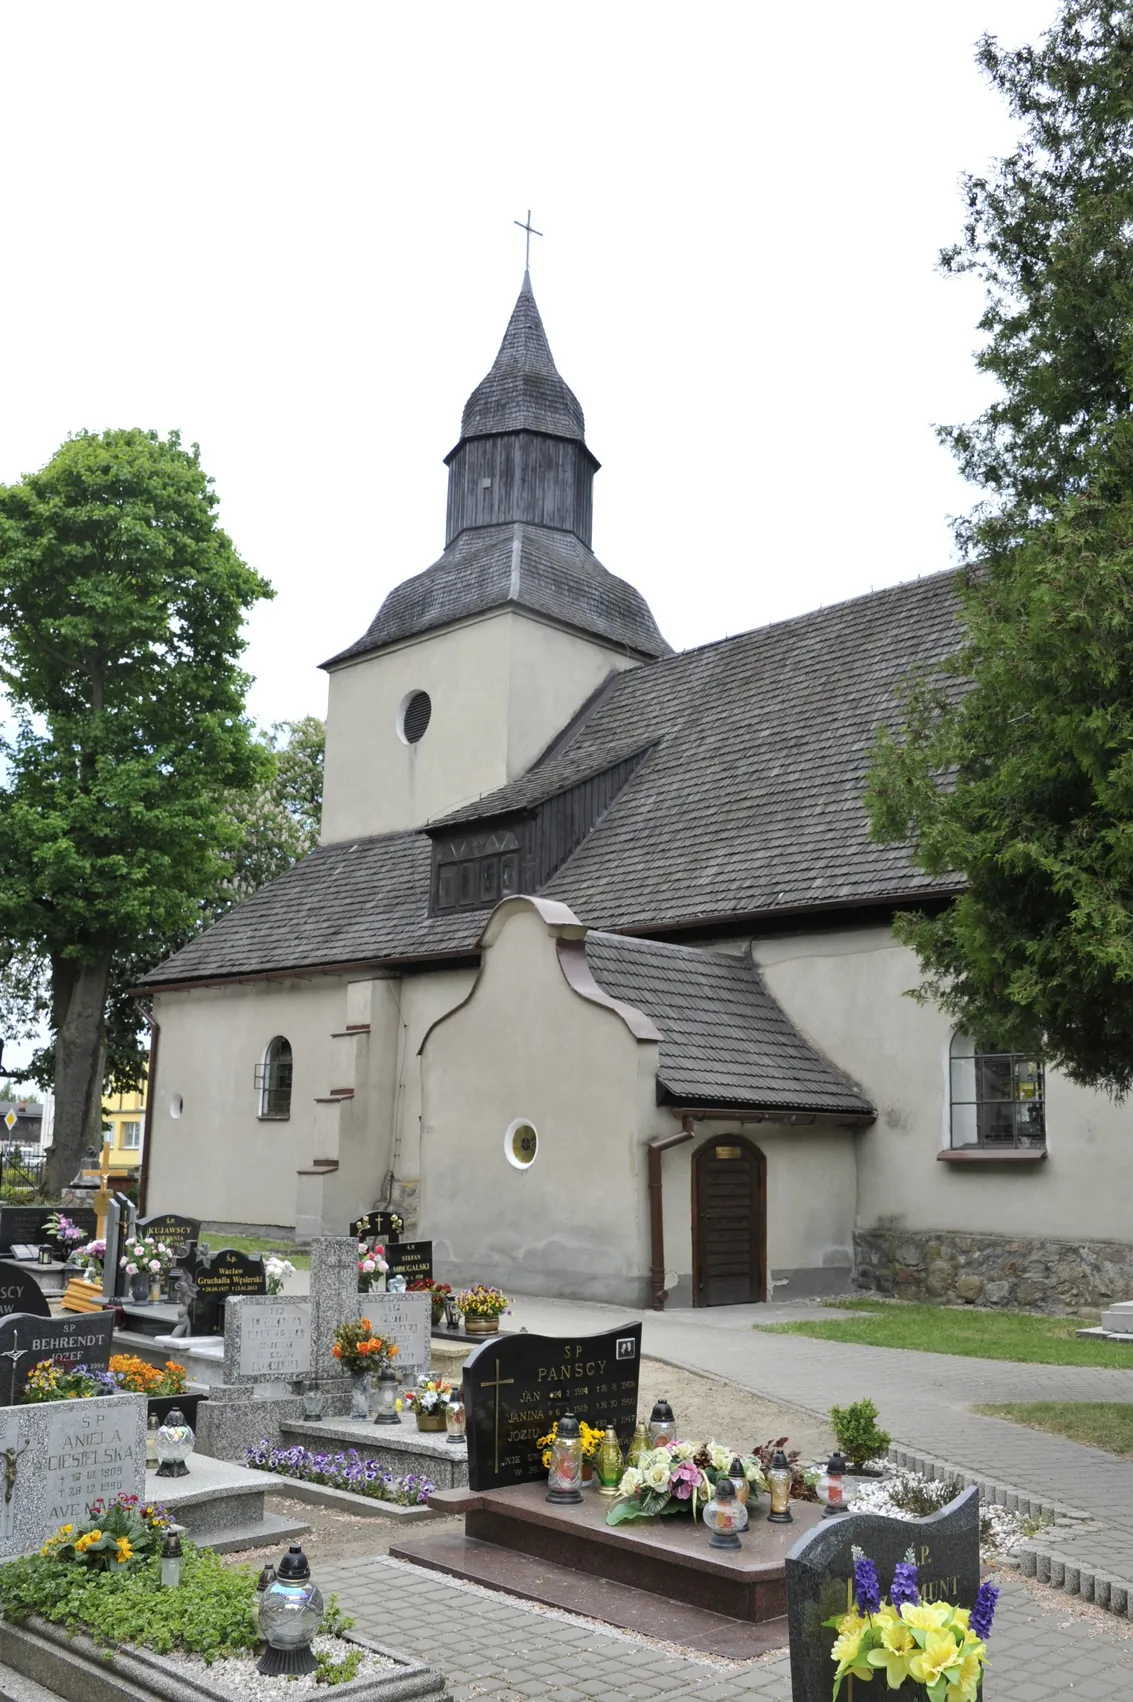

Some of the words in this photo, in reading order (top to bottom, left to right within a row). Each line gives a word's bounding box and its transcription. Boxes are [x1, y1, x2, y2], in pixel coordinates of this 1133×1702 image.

[31, 1334, 105, 1351] BEHRENDT
[537, 1360, 607, 1382] PANSCY
[519, 1390, 541, 1403] JAN
[507, 1409, 544, 1423] JANINA
[62, 1430, 122, 1450] ANIELA
[48, 1503, 80, 1520] AVE
